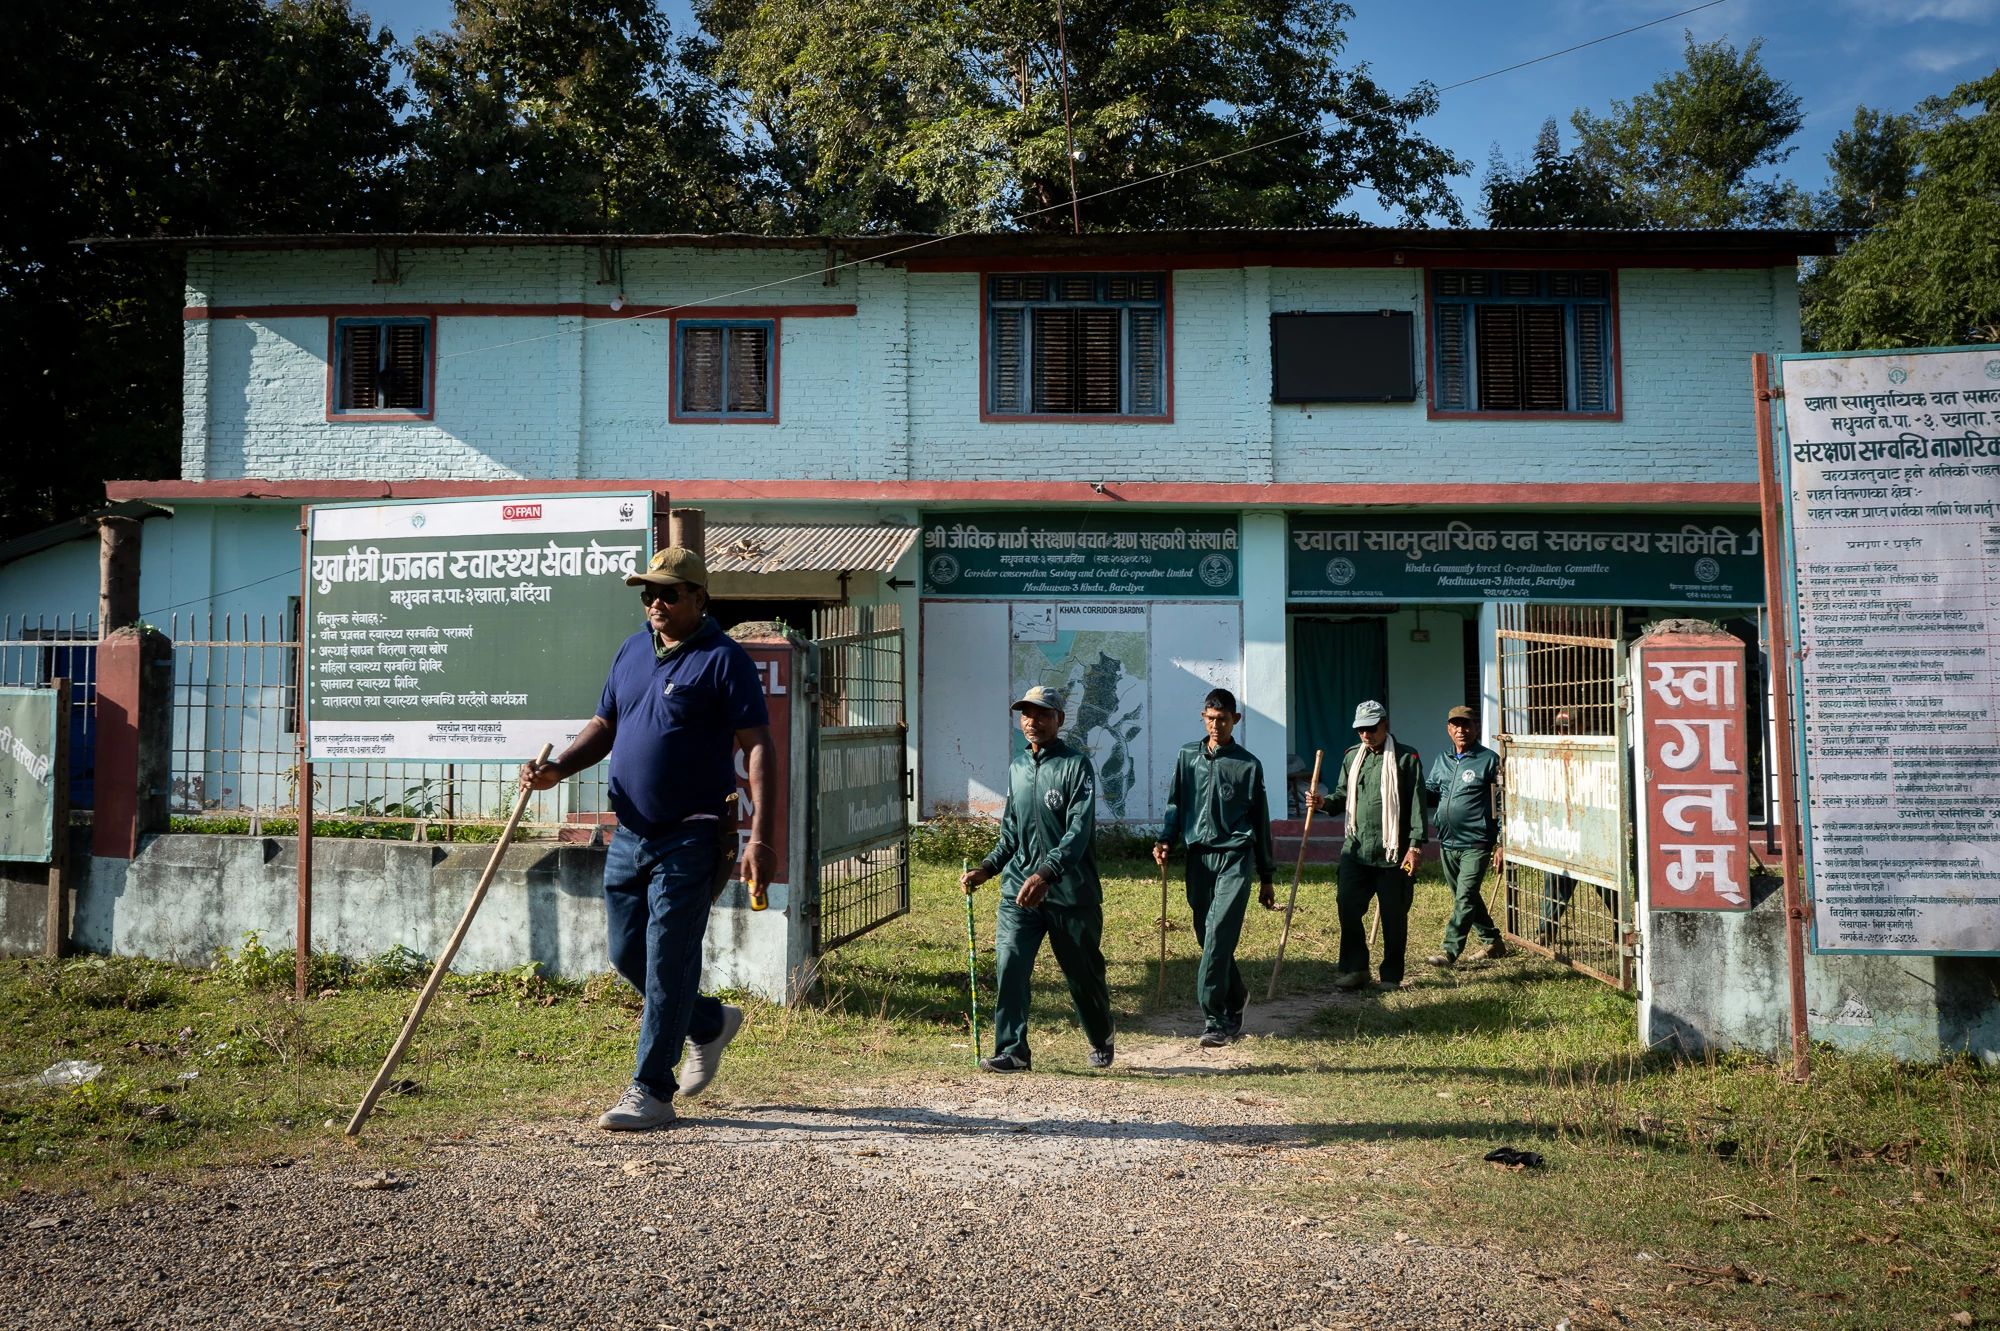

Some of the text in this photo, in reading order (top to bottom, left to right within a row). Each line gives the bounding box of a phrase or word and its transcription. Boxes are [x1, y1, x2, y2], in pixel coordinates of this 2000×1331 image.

[1805, 396, 1837, 411] खाता
[1931, 392, 1959, 406] वन
[1793, 439, 1856, 463] संरक्षण
[516, 505, 541, 518] FPAN
[924, 524, 946, 549] श्री
[948, 523, 996, 549] जैविक
[997, 526, 1030, 549] मार्ग
[1030, 529, 1076, 549] संरक्षण
[1140, 527, 1186, 550] सहकारी
[1364, 520, 1497, 560] सामुदायिक
[1501, 530, 1539, 551] वन
[1543, 531, 1651, 553] समन्वय
[1654, 524, 1739, 555] समिति
[312, 554, 346, 594] युवा
[345, 545, 380, 582] मैत्री
[380, 551, 448, 584] प्रजनन
[449, 548, 541, 579] स्वास्थ्य
[540, 540, 584, 577] सेवा
[964, 568, 1194, 580] Corridor conservation Saving and Credit Co-operative Limited
[1405, 563, 1432, 573] Khata
[1433, 563, 1475, 575] Community
[1565, 563, 1610, 573] Committee
[1109, 582, 1144, 594] Bardiya
[1535, 576, 1575, 589] Bardiya
[390, 589, 431, 610] मधुवन
[1083, 606, 1118, 614] CORRIDOR
[409, 644, 427, 657] तथा
[319, 659, 347, 676] महिला
